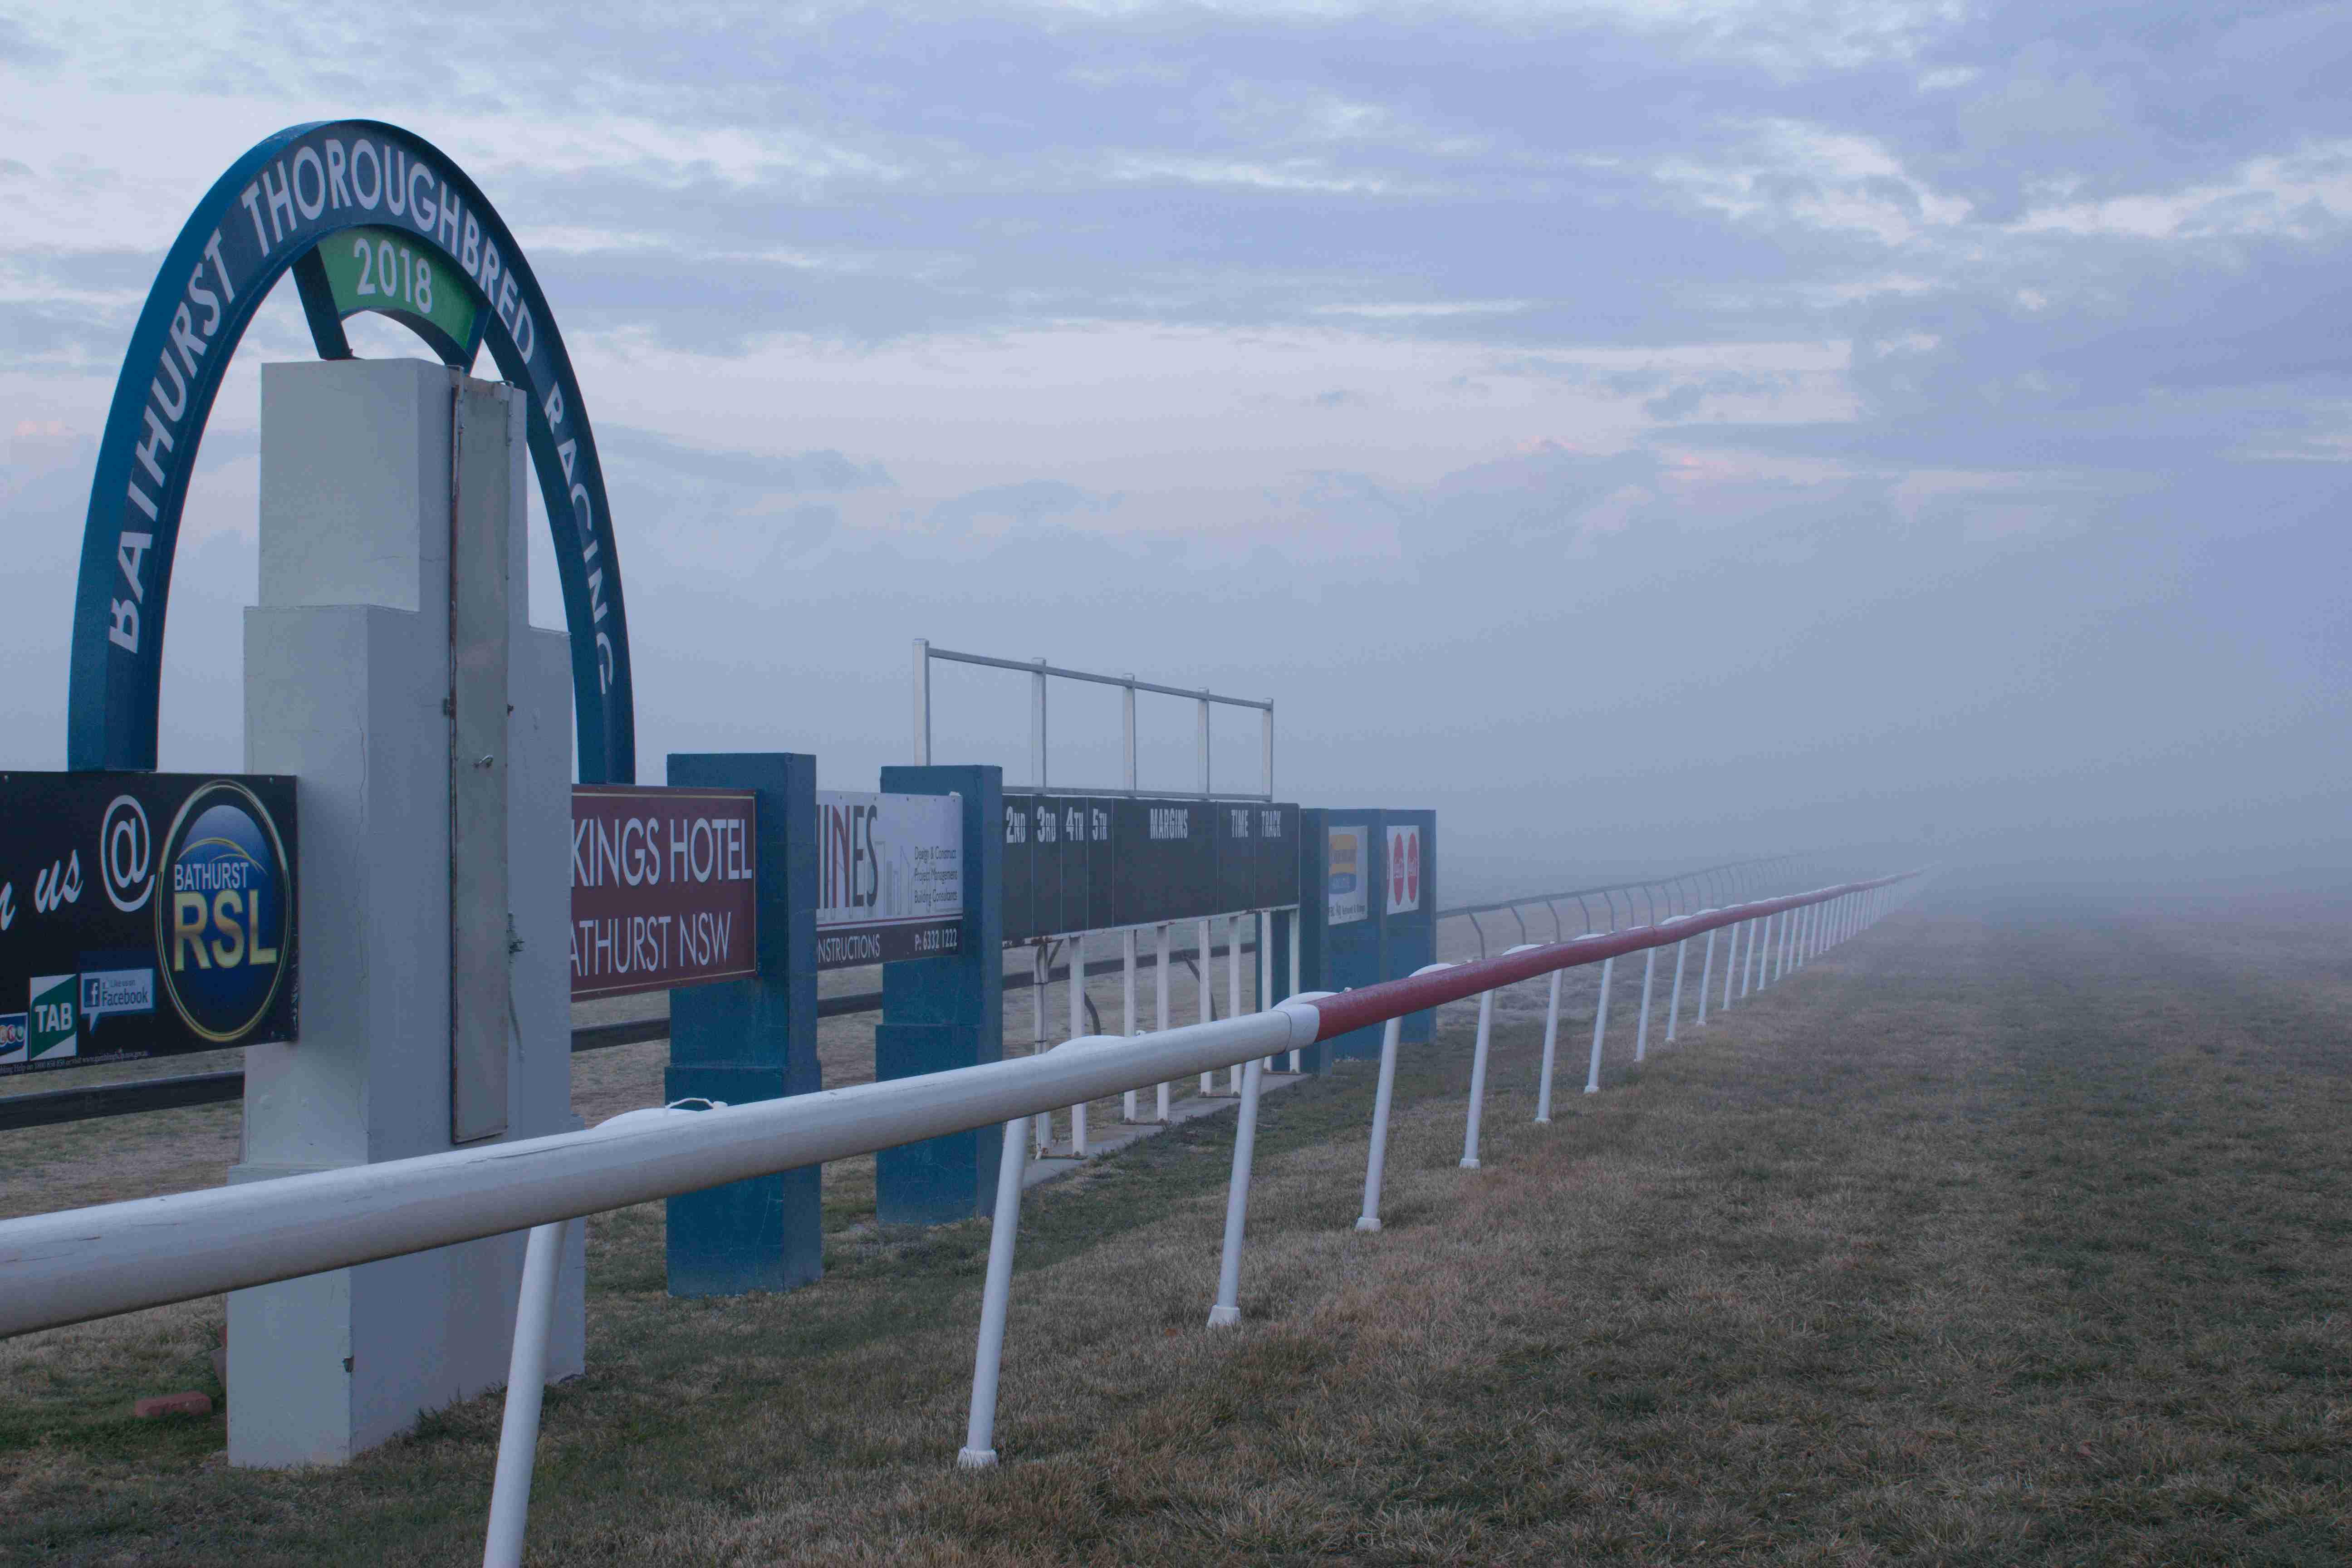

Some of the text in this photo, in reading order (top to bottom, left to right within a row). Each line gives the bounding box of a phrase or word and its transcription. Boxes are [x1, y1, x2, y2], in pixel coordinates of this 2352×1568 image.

[354, 238, 432, 314] 2018
[241, 138, 534, 364] THOROUGHBRED
[544, 381, 613, 695] RACING
[1006, 806, 1026, 843] 2ND
[1037, 806, 1056, 843] 3RD
[1066, 807, 1084, 841] 4TH
[1093, 808, 1107, 841] 5TH
[1150, 808, 1188, 839] MARGINS
[1231, 809, 1249, 838] TIME
[1261, 810, 1281, 837] TRACK
[572, 815, 753, 888] KINGS HOTEL
[816, 804, 878, 909] INES
[34, 849, 83, 913] us
[174, 862, 250, 891] BATHURST
[174, 889, 277, 971] RSL
[681, 911, 731, 967] NSW
[915, 928, 957, 951] P: 6332 1222
[103, 986, 148, 1006] Facebook
[34, 1001, 73, 1033] TAB
